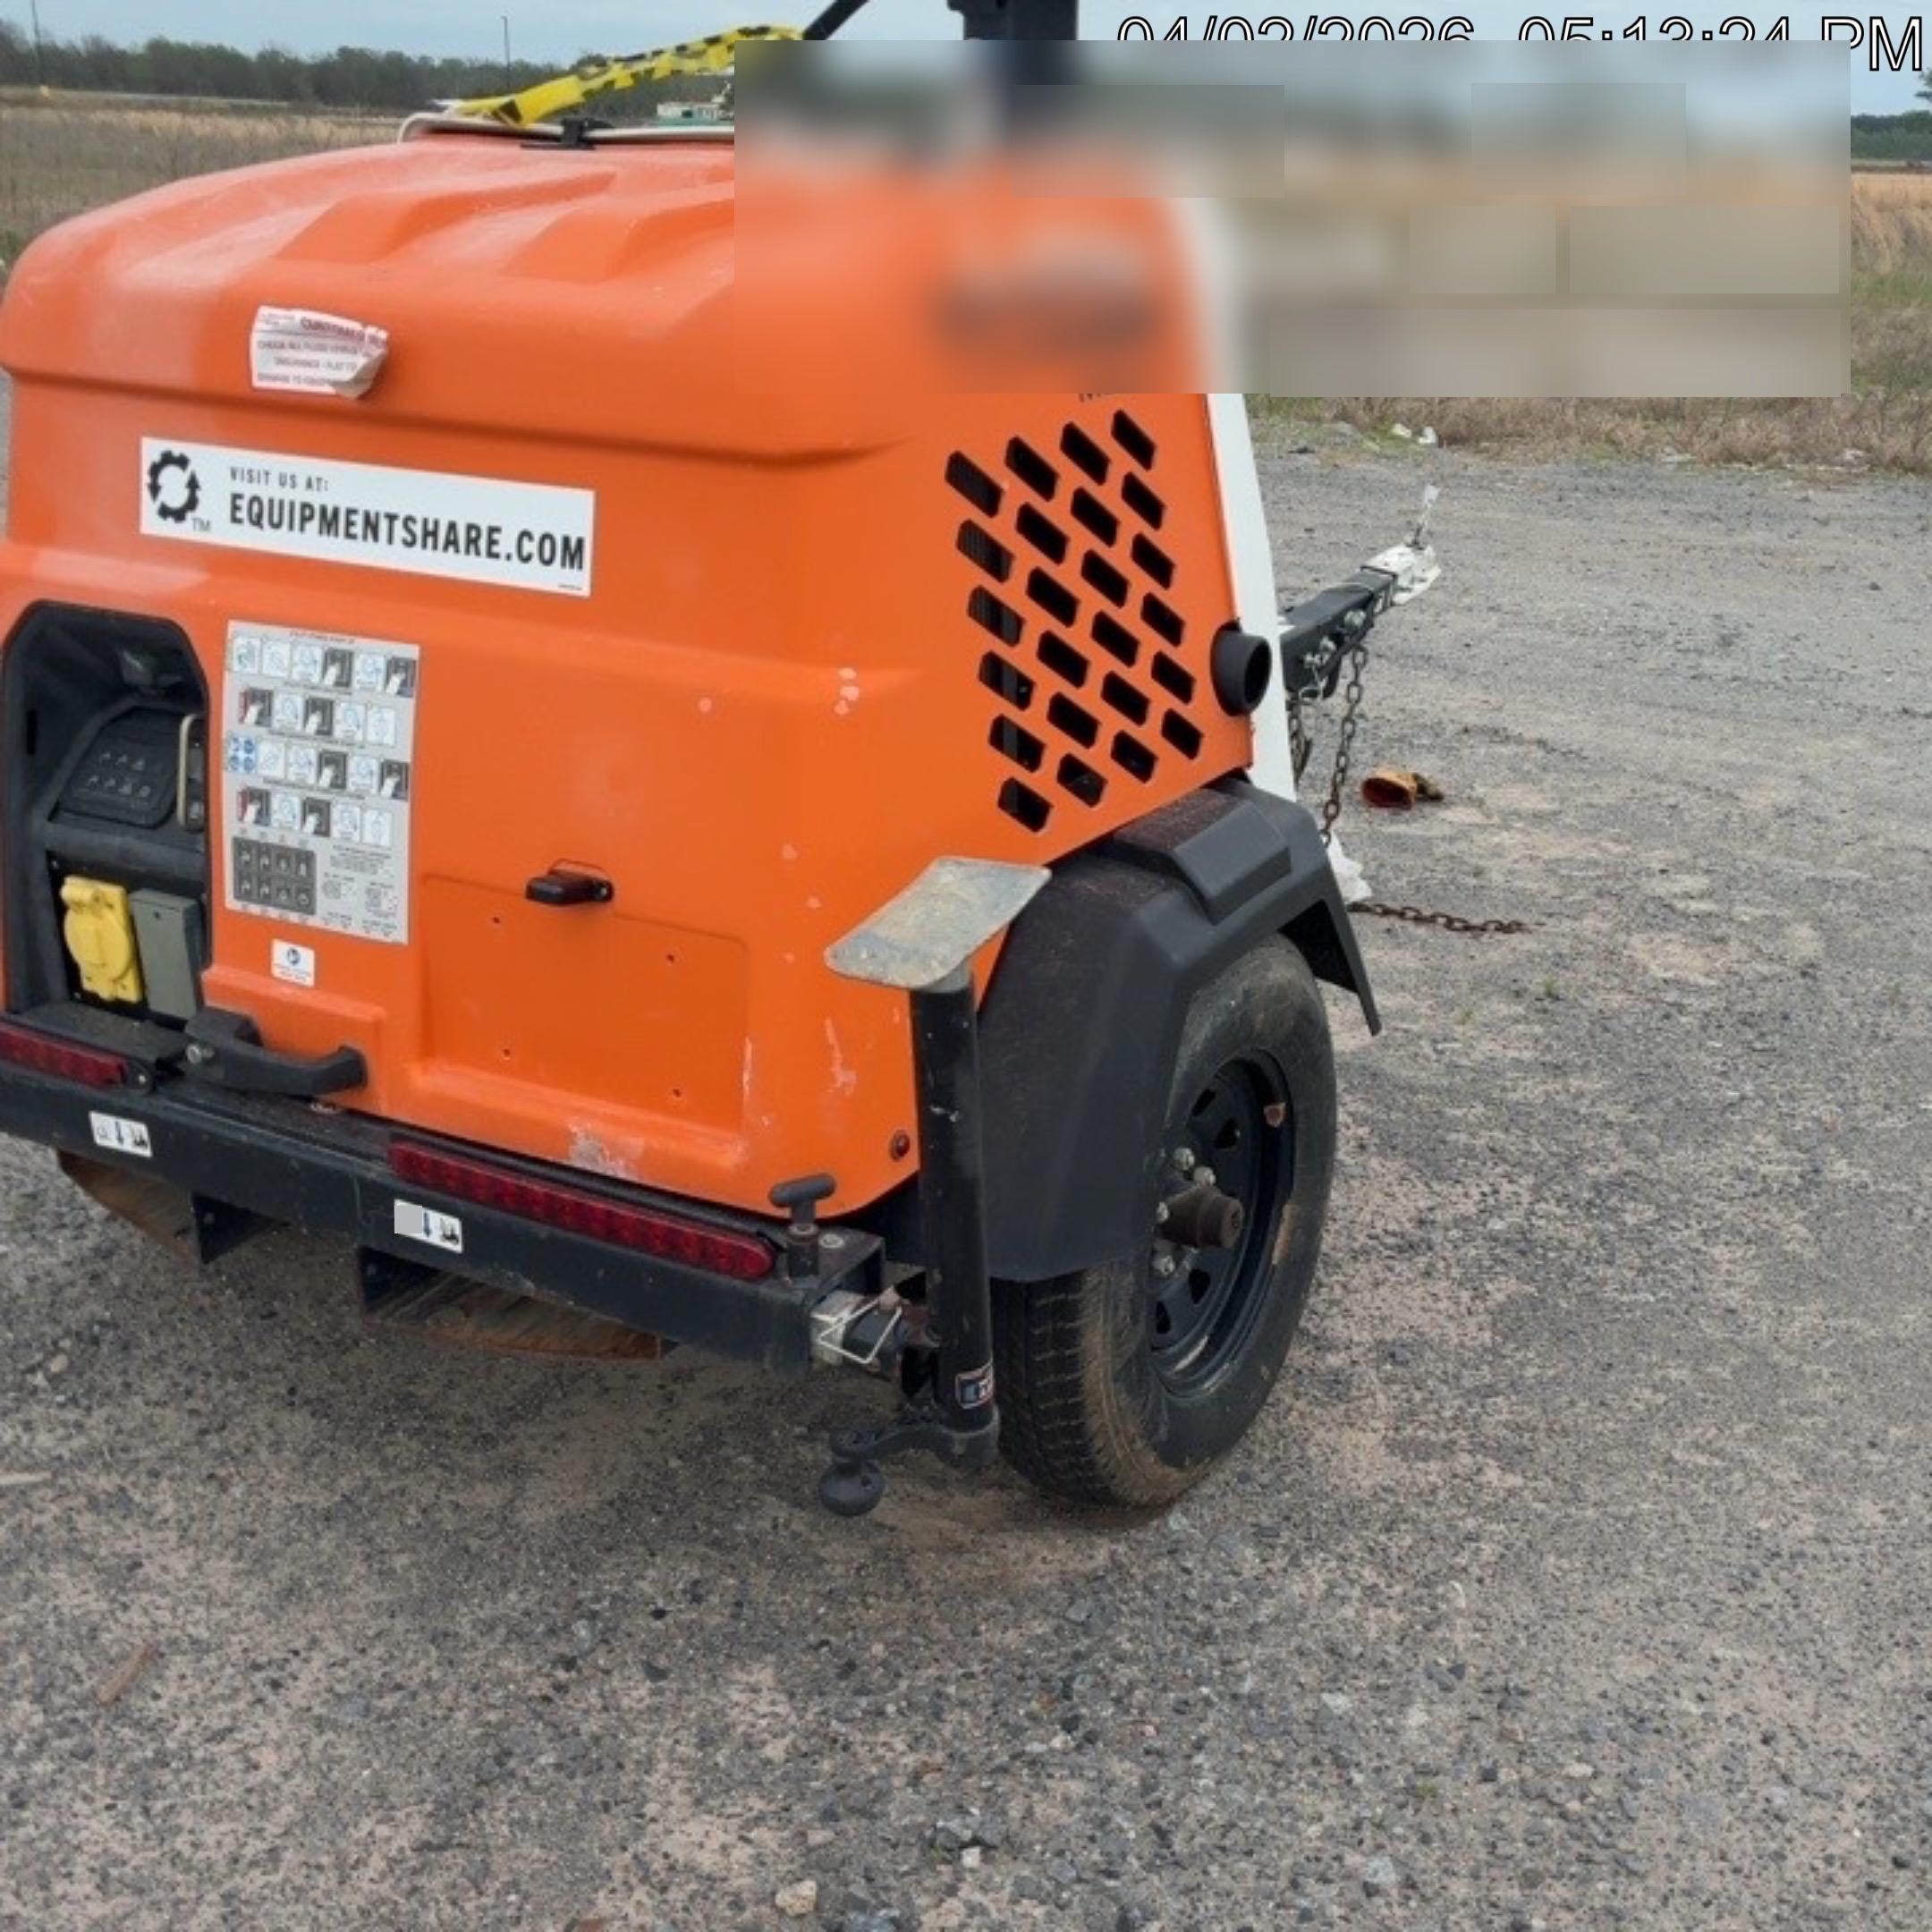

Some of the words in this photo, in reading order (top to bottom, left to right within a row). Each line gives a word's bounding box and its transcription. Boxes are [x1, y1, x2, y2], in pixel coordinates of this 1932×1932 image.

[230, 467, 271, 486] VISIT
[279, 472, 298, 489] US
[306, 476, 329, 492] AT:
[191, 517, 211, 532] TM
[230, 493, 586, 571] EQUIPMENTSHARE.COM
